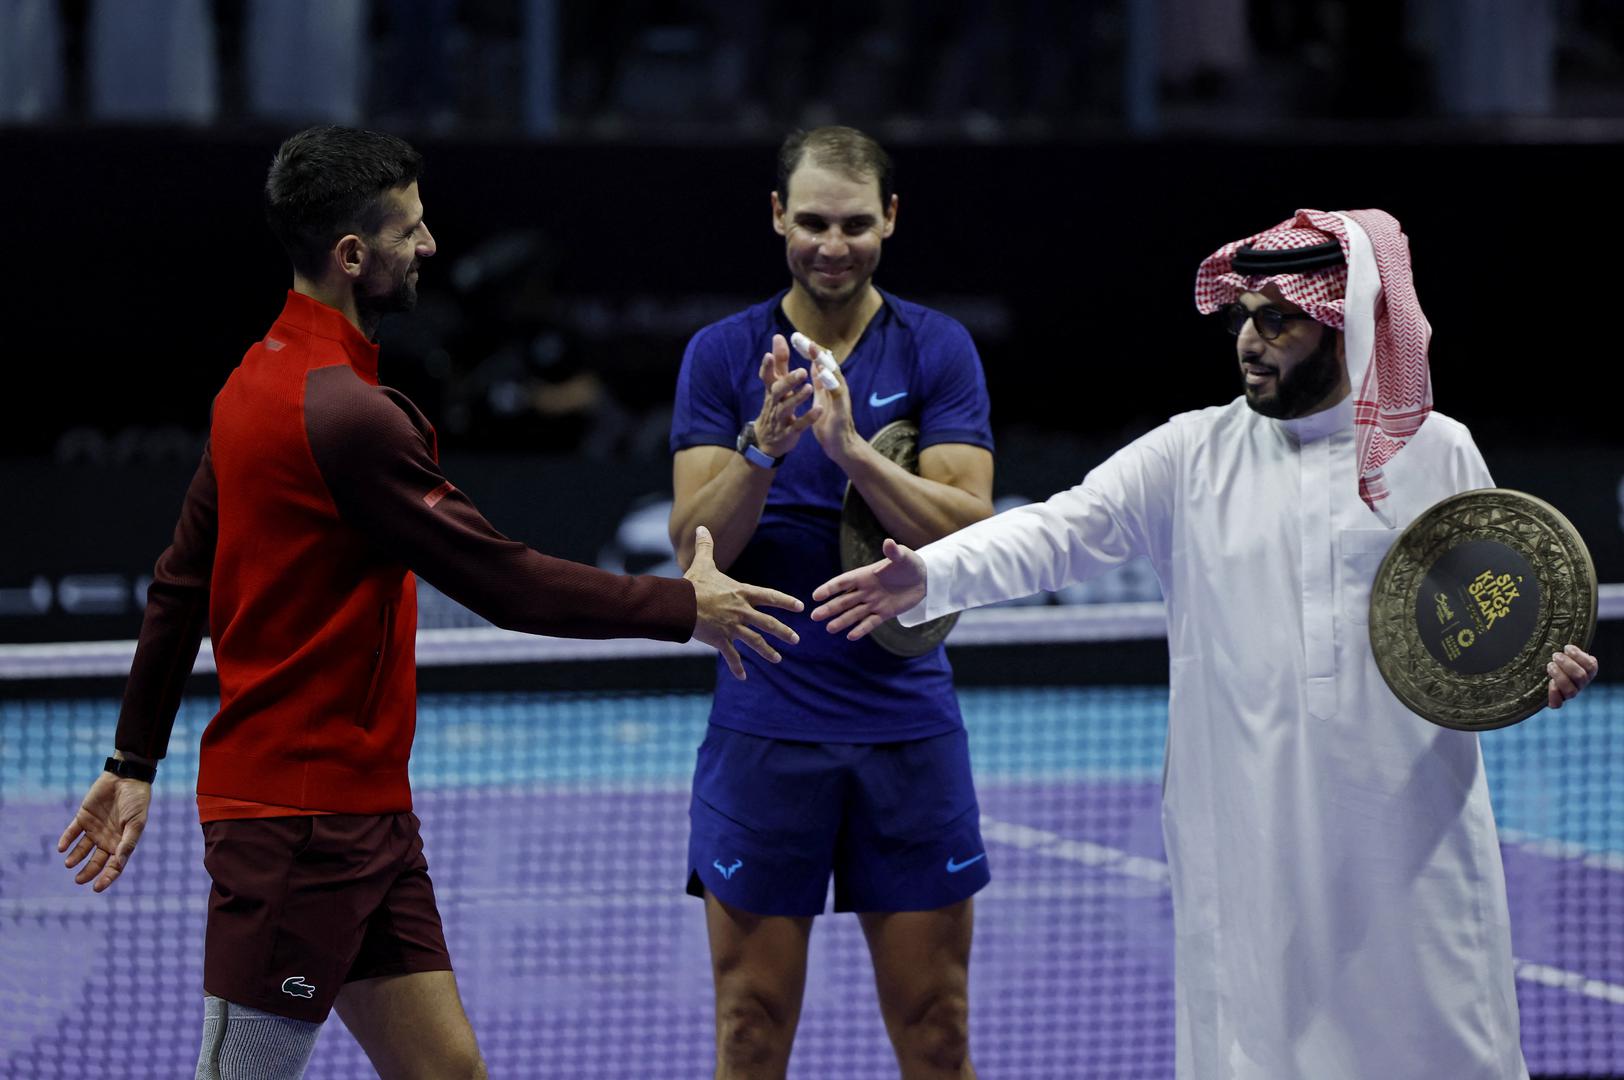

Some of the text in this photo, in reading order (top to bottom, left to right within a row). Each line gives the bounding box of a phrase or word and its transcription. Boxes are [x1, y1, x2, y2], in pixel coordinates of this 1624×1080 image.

[1468, 582, 1497, 630] SLAM
[1475, 569, 1510, 618] KINGS
[1496, 573, 1520, 604] SIX
